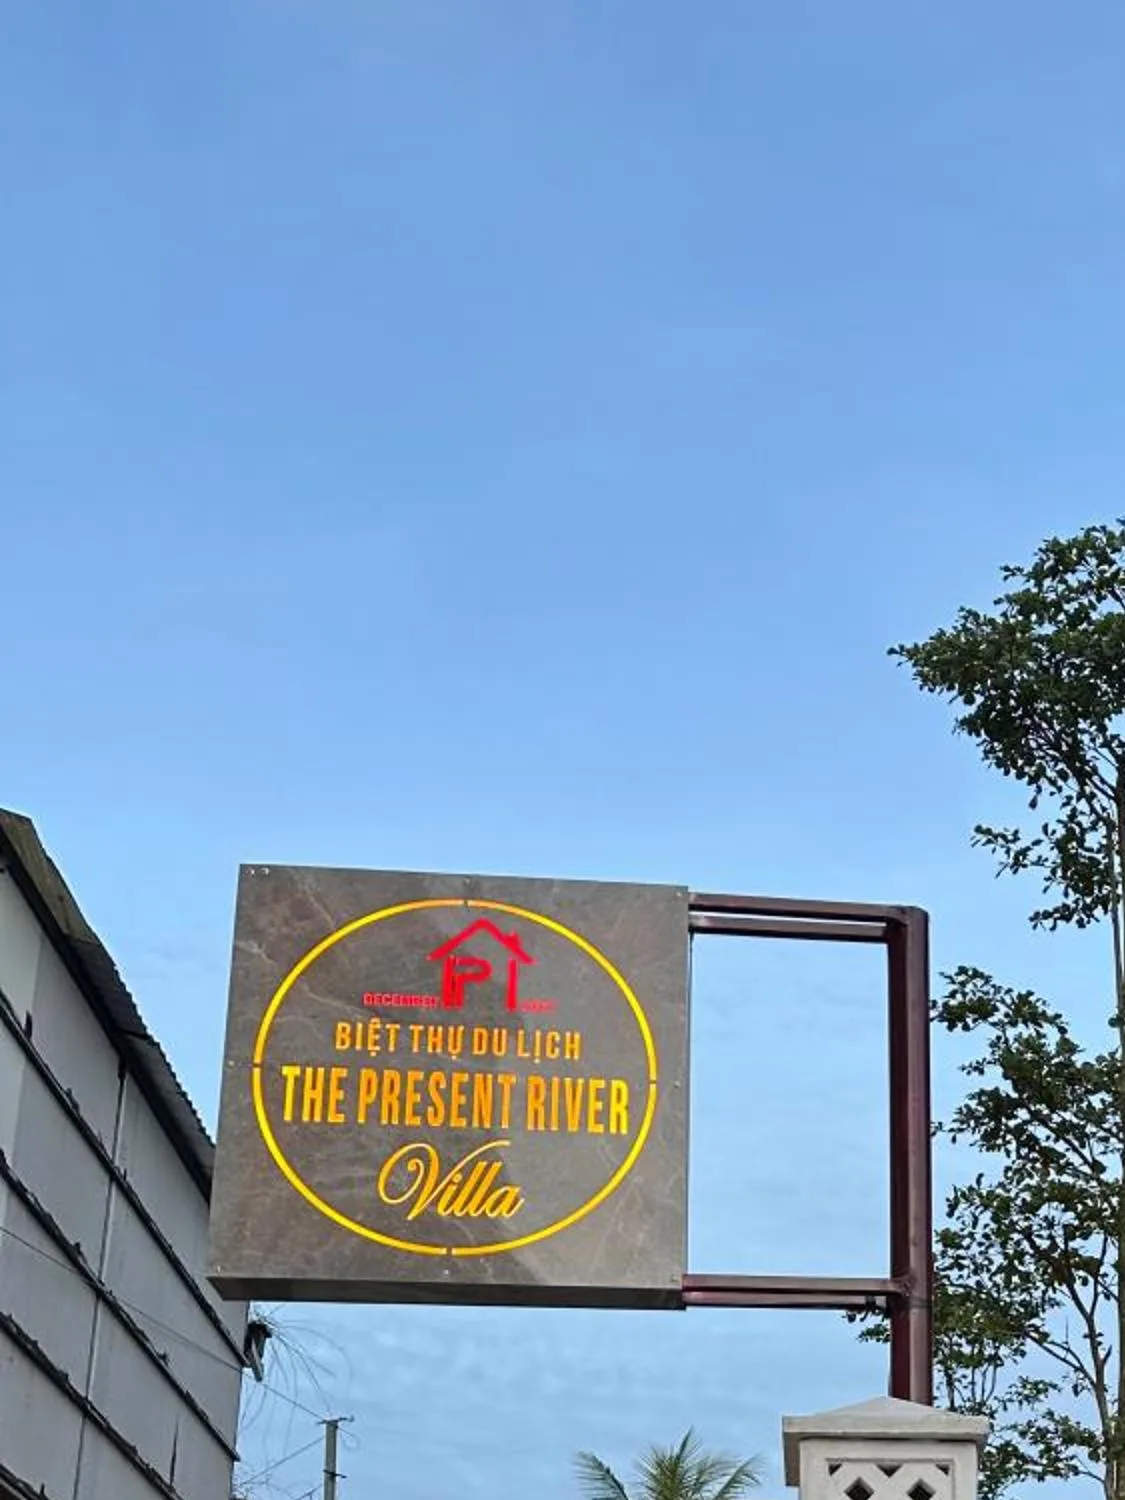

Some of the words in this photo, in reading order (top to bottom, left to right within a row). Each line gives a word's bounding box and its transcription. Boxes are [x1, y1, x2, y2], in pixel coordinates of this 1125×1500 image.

[334, 1017, 401, 1057] BIỆT
[410, 1024, 465, 1060] THỤ
[472, 1026, 509, 1058] DU
[516, 1028, 582, 1064] LỊCH
[281, 1063, 349, 1126] THE
[356, 1066, 517, 1131] PRESENT
[525, 1073, 631, 1137] RIVER
[376, 1139, 526, 1221] Villa
